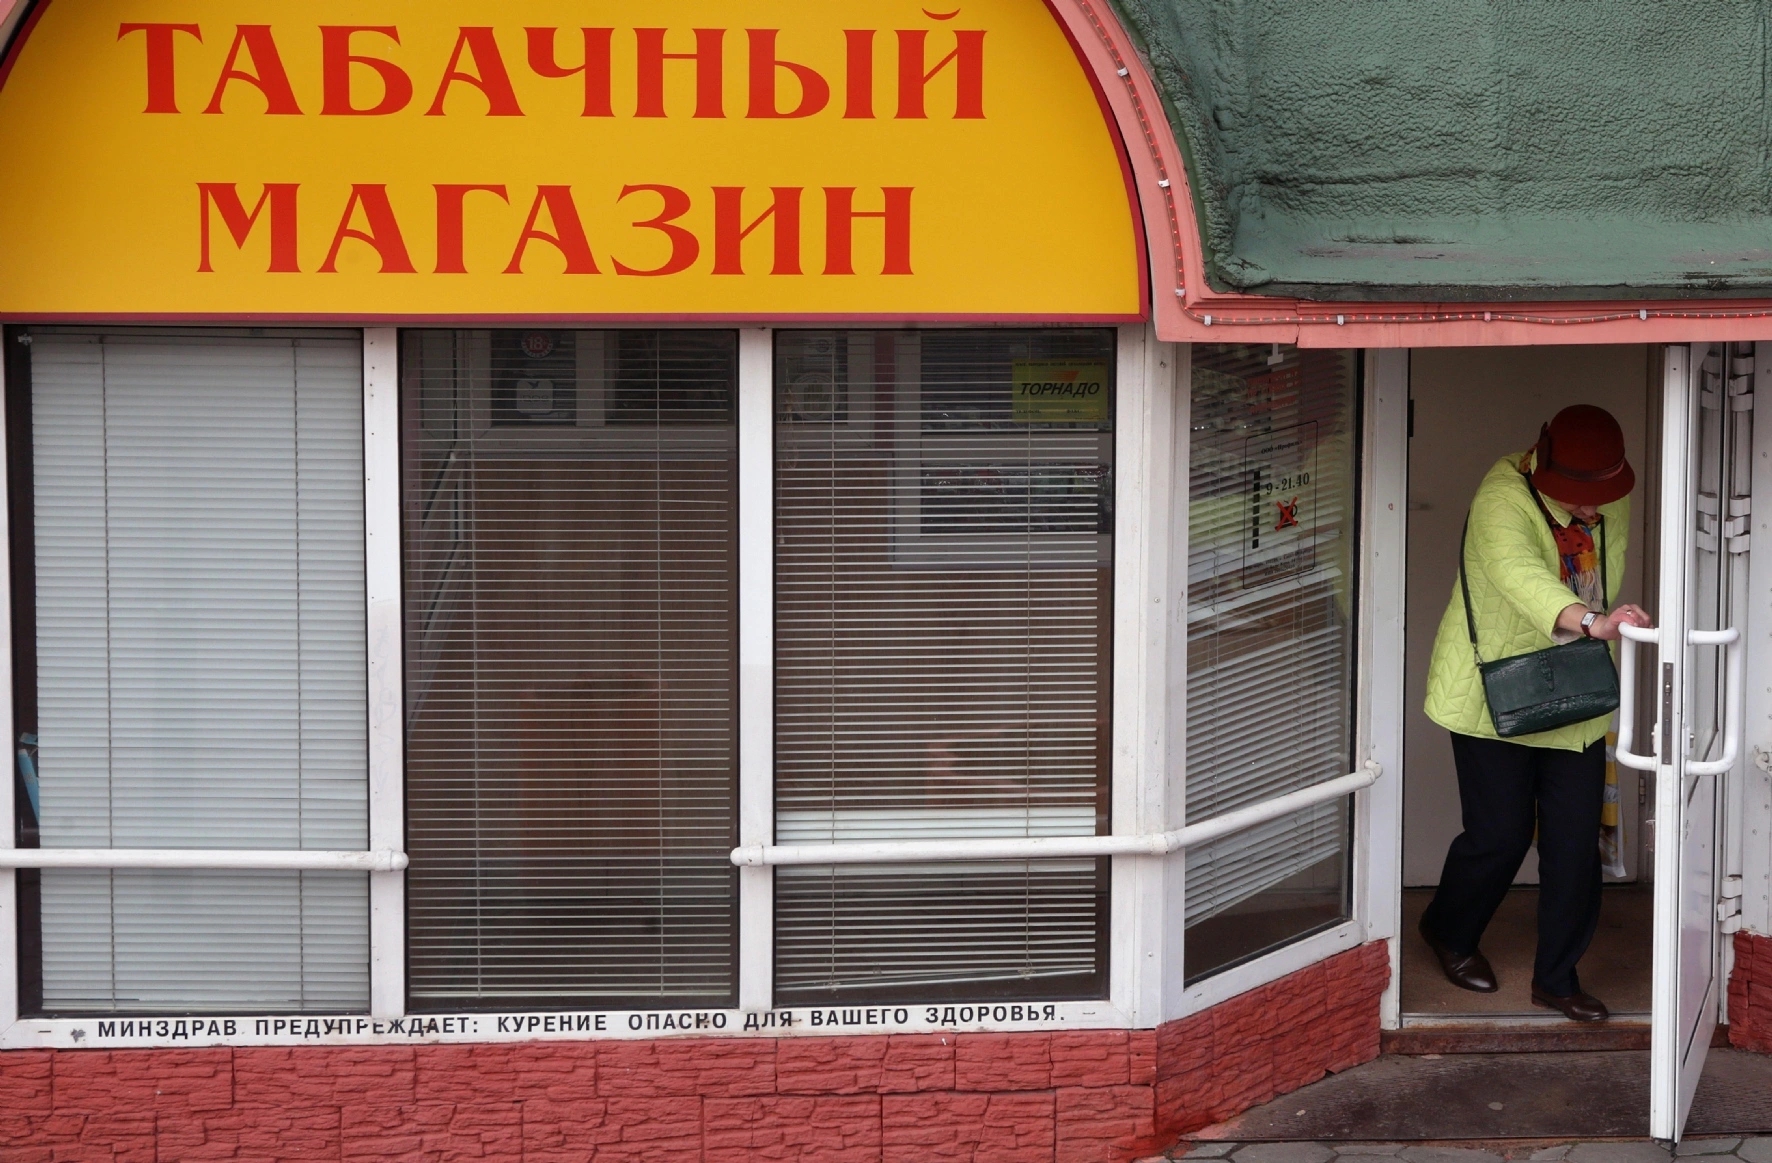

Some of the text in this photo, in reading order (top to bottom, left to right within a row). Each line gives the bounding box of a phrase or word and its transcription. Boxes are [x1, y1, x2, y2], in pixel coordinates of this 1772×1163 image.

[119, 9, 985, 119] ТАБАЧНЫЙ
[197, 183, 914, 276] МАГАЗИН
[1020, 382, 1100, 398] ТОРНАДО
[1266, 482, 1273, 495] 9
[98, 1004, 1066, 1039] МИНЗДРАВ ПРЕДУПРЕЖДАЕТ: КУРЕНИЕ ОПАСНО ДЛЯ ВАШЕГО ЗДОРОВЬЯ.
